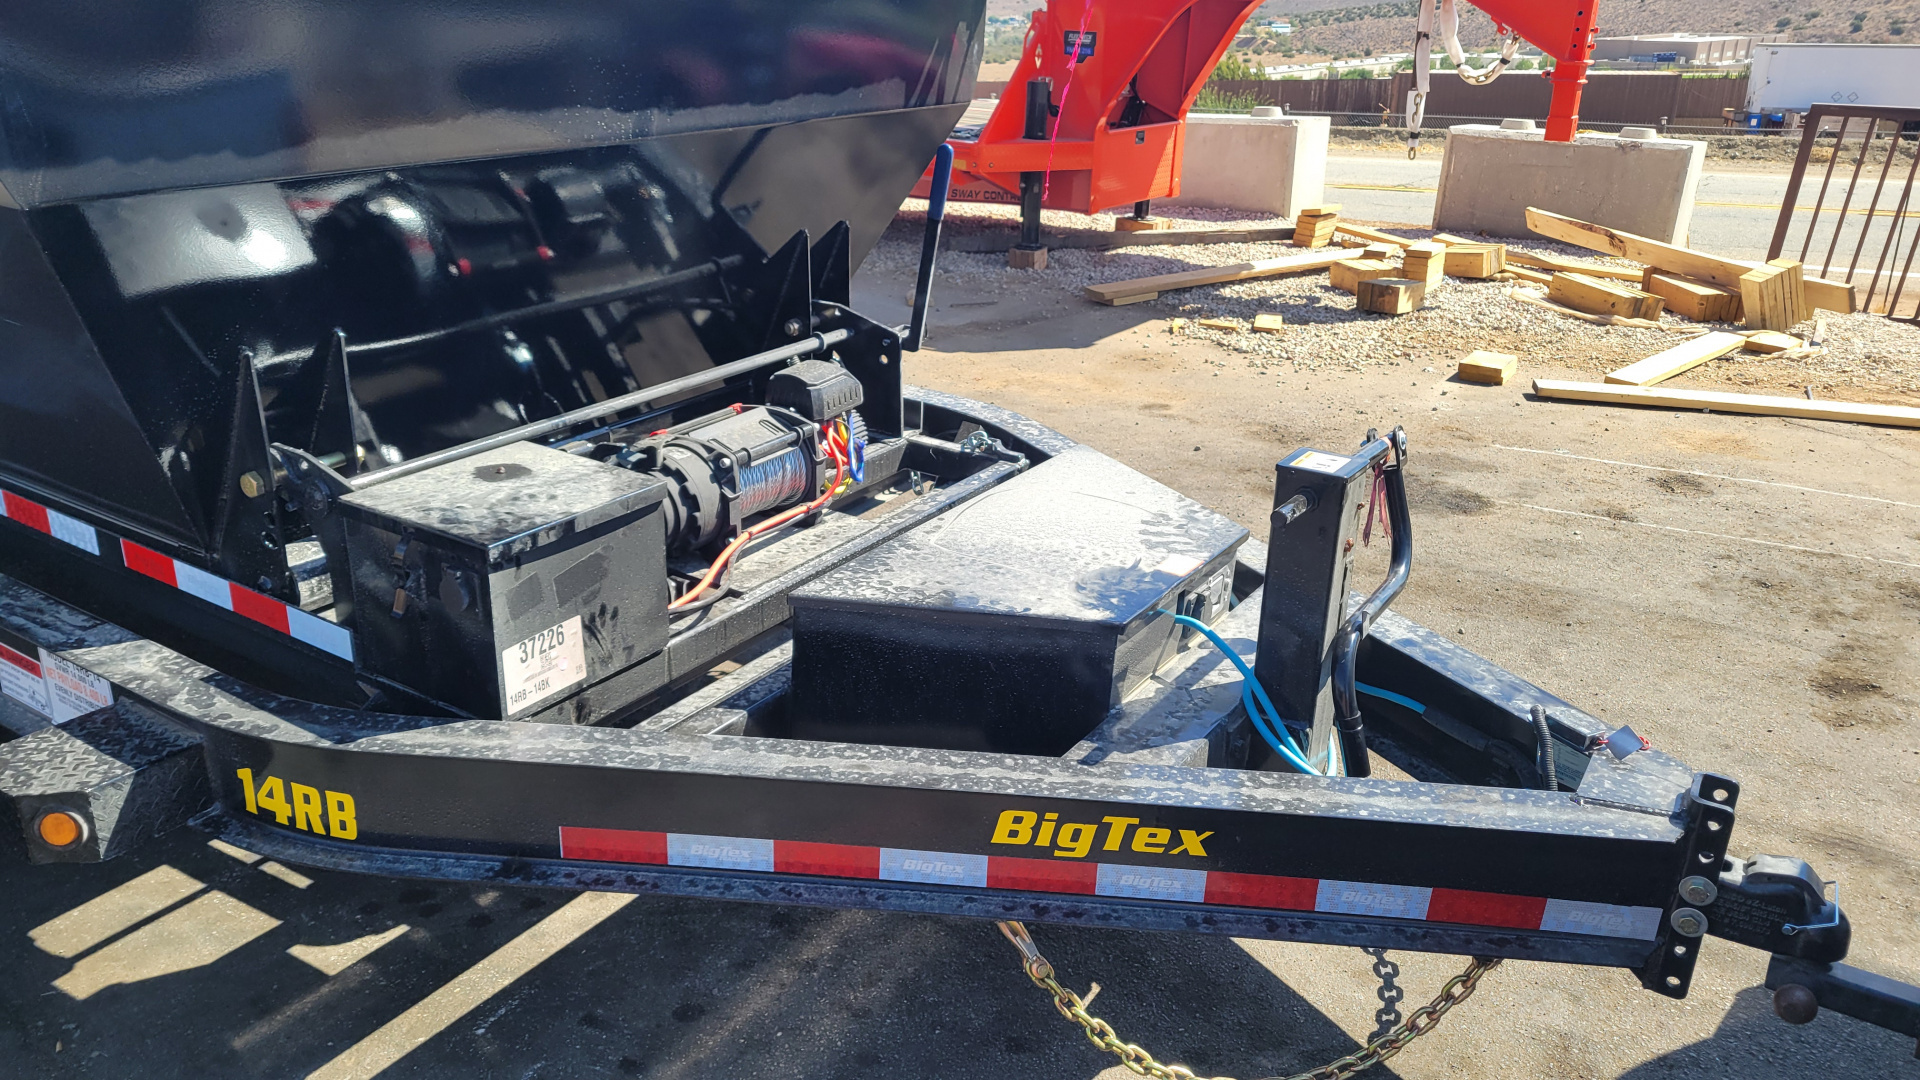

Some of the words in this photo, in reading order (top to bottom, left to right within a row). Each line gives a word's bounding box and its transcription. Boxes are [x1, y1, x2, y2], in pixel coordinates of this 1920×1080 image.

[951, 188, 981, 199] SWAY
[519, 624, 565, 664] 37226
[237, 768, 358, 840] 14RB
[991, 810, 1215, 858] BigTex
[690, 845, 752, 858] BigTex
[903, 859, 965, 874] BigTex
[1119, 874, 1182, 889] BigTex
[1341, 891, 1407, 905] BigTex
[1567, 910, 1635, 926] BigTex
